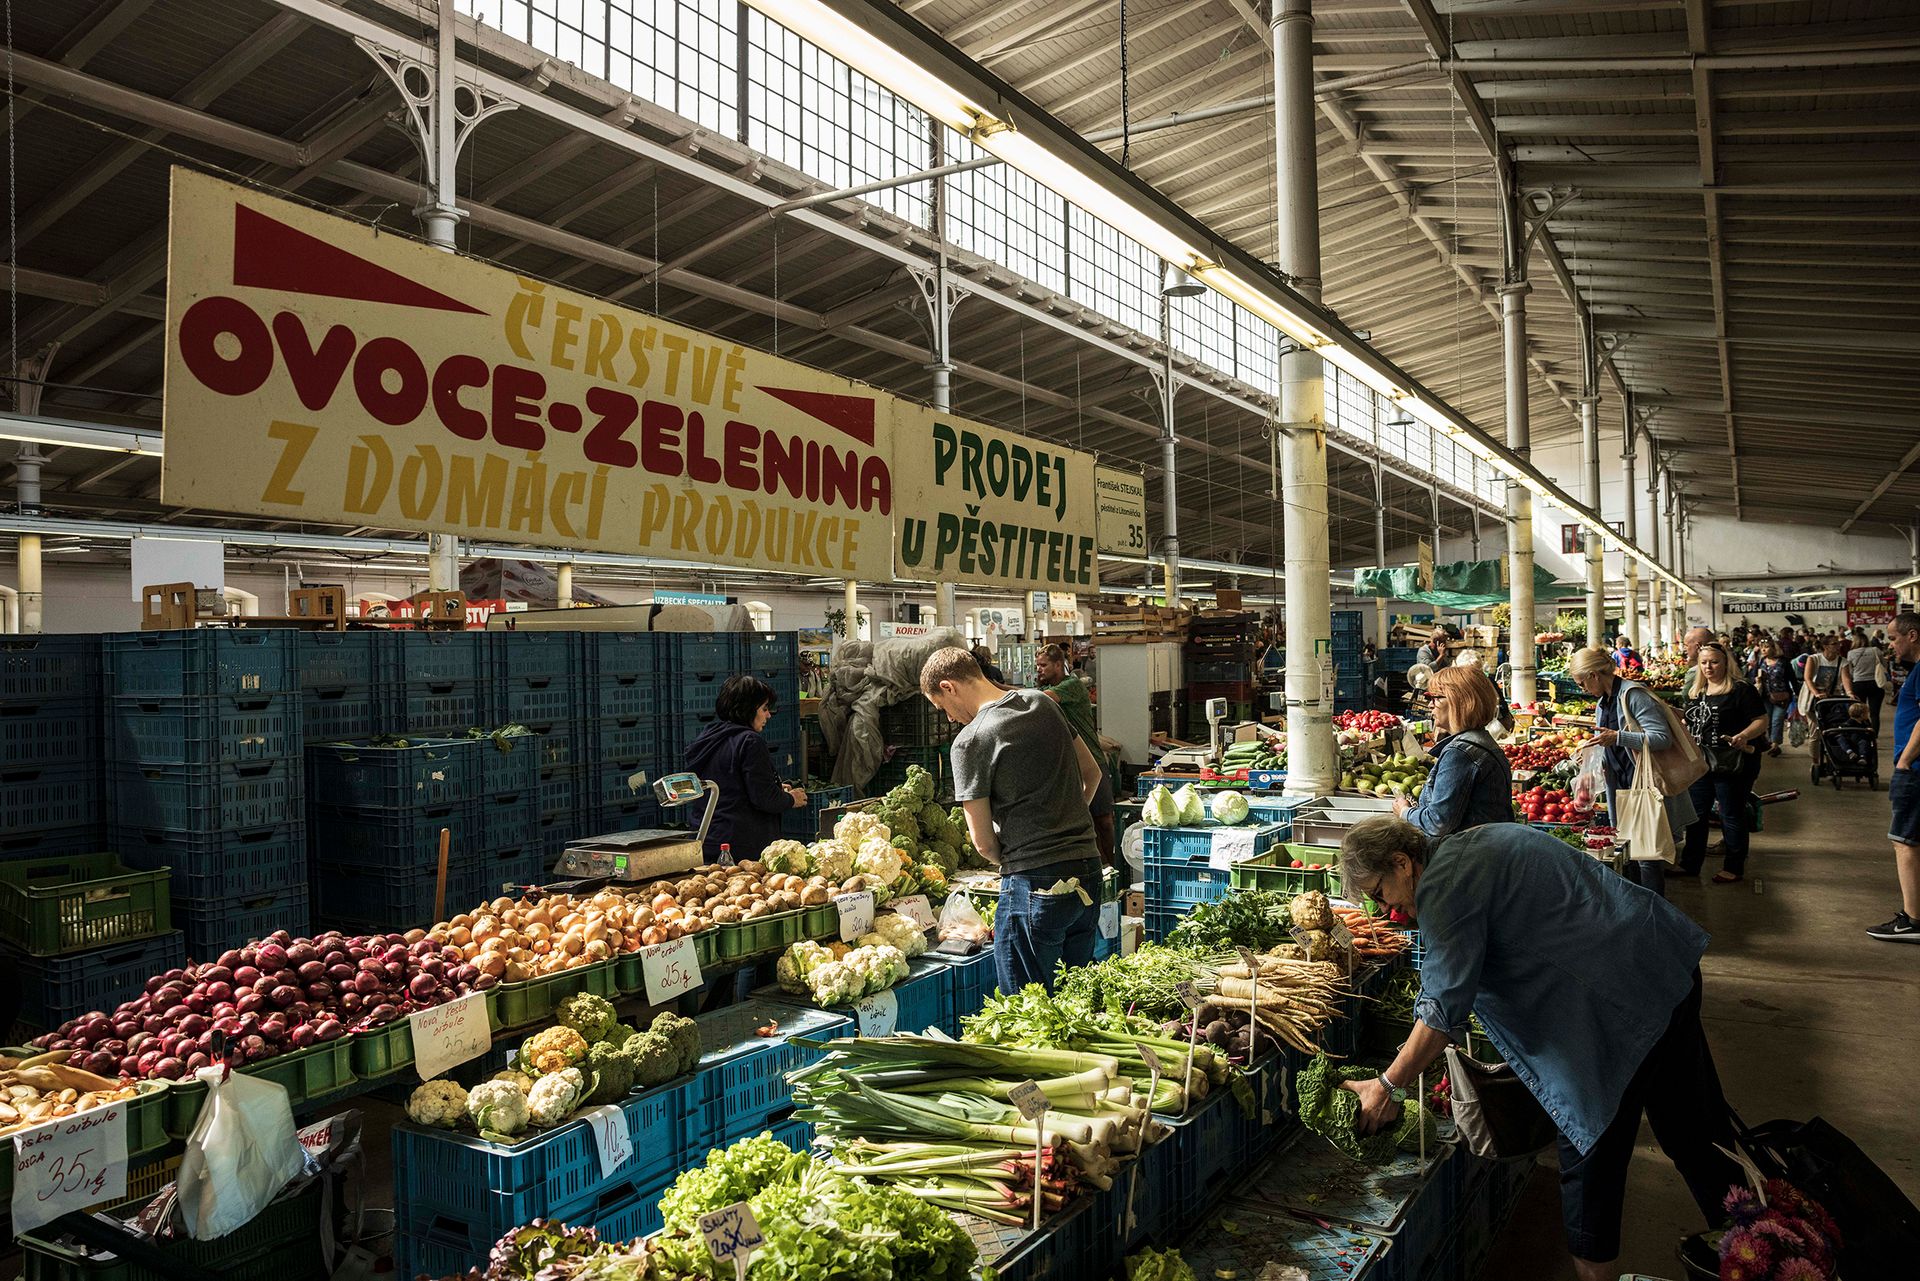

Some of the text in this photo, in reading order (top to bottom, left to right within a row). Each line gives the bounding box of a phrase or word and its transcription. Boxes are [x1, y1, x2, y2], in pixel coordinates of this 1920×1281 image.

[505, 276, 747, 414] ČERSTVÉ
[179, 296, 892, 516] OVOCE-ZELENINA
[261, 420, 861, 571] Z DOMÁCÍ PRODUKCE
[932, 420, 1067, 524] PRODEJ
[902, 502, 1094, 586] U PĚSTITELE
[1128, 524, 1143, 548] 35
[655, 596, 686, 605] UZBECKÉ
[1729, 601, 1846, 612] PRODEJ RYB FISH MARKET
[21, 1125, 59, 1150] eská
